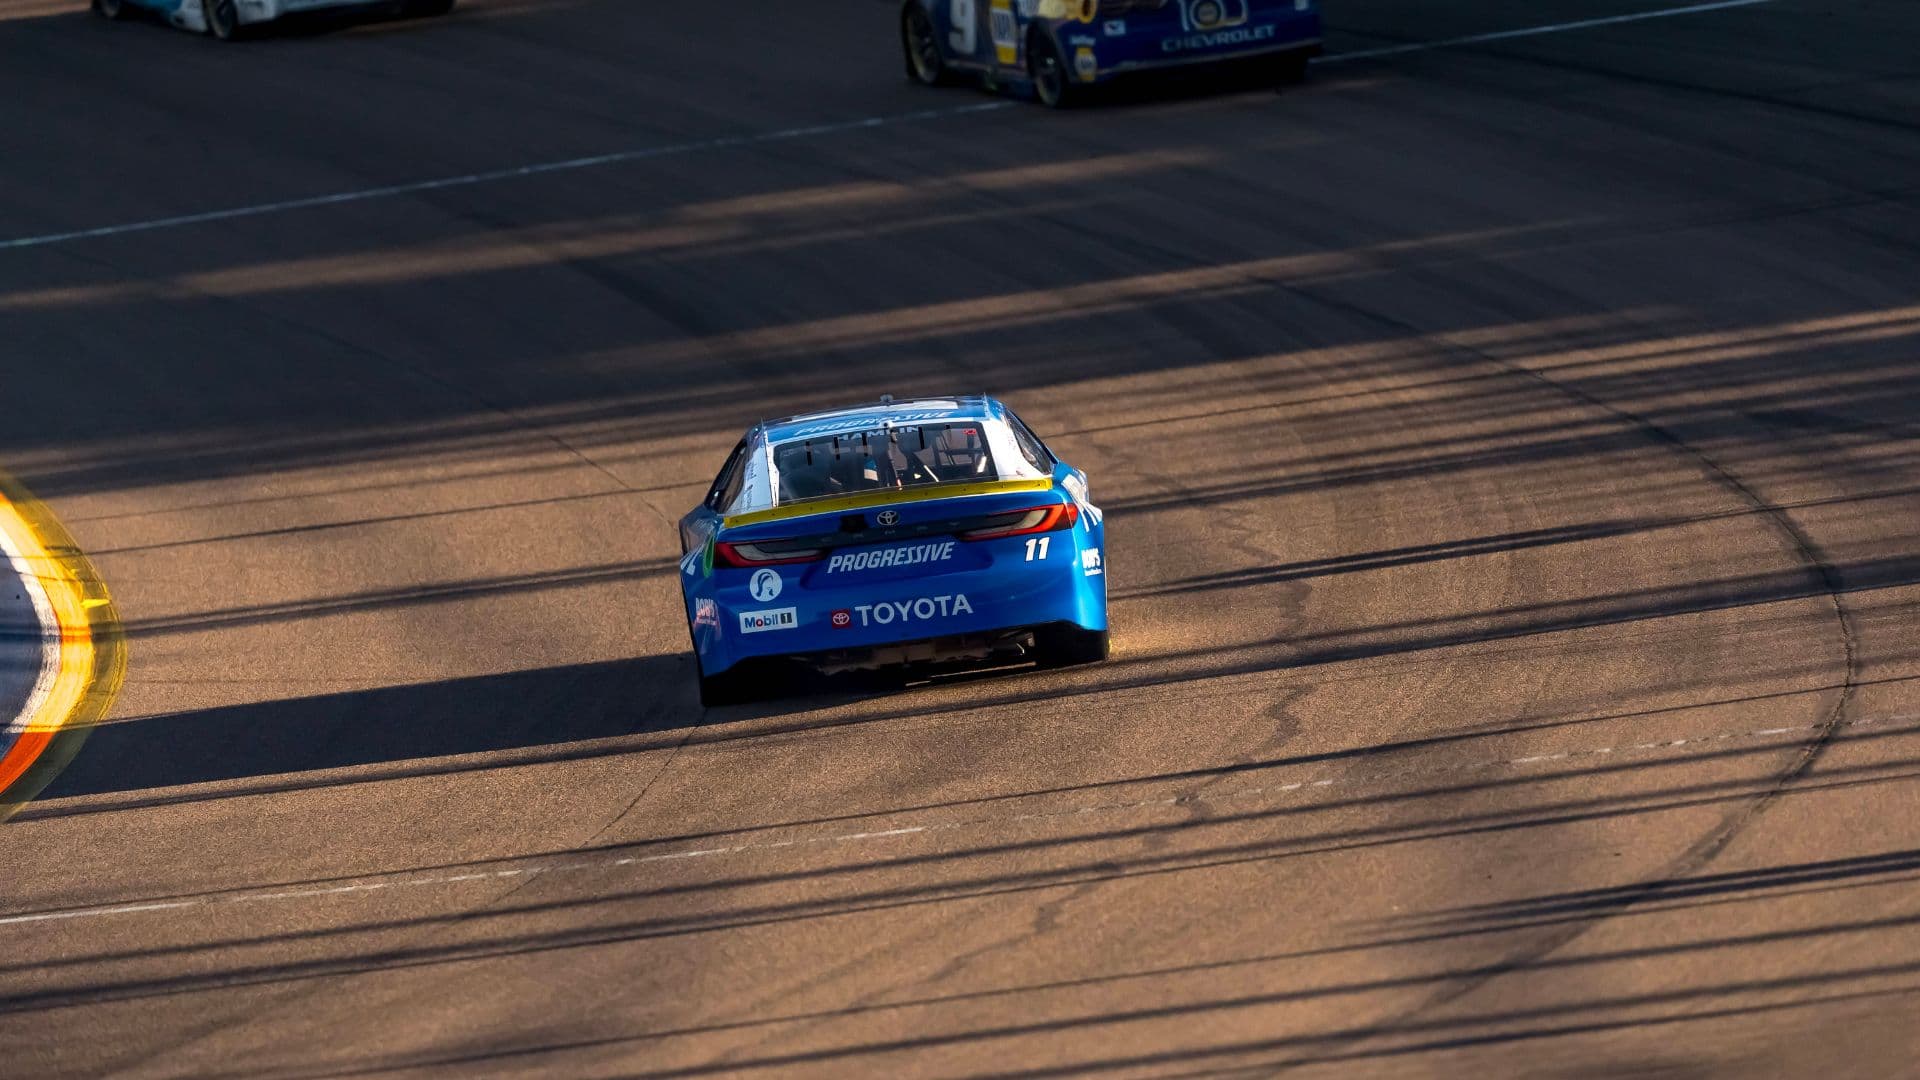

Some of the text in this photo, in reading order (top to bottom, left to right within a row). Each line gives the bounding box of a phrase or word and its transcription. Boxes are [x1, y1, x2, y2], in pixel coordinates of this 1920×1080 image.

[1161, 23, 1277, 52] CHEVROLET
[827, 541, 956, 574] PROGRESSIVE
[1024, 537, 1050, 561] 11
[744, 612, 793, 629] Mobil 1
[854, 593, 974, 627] TOYOTA
